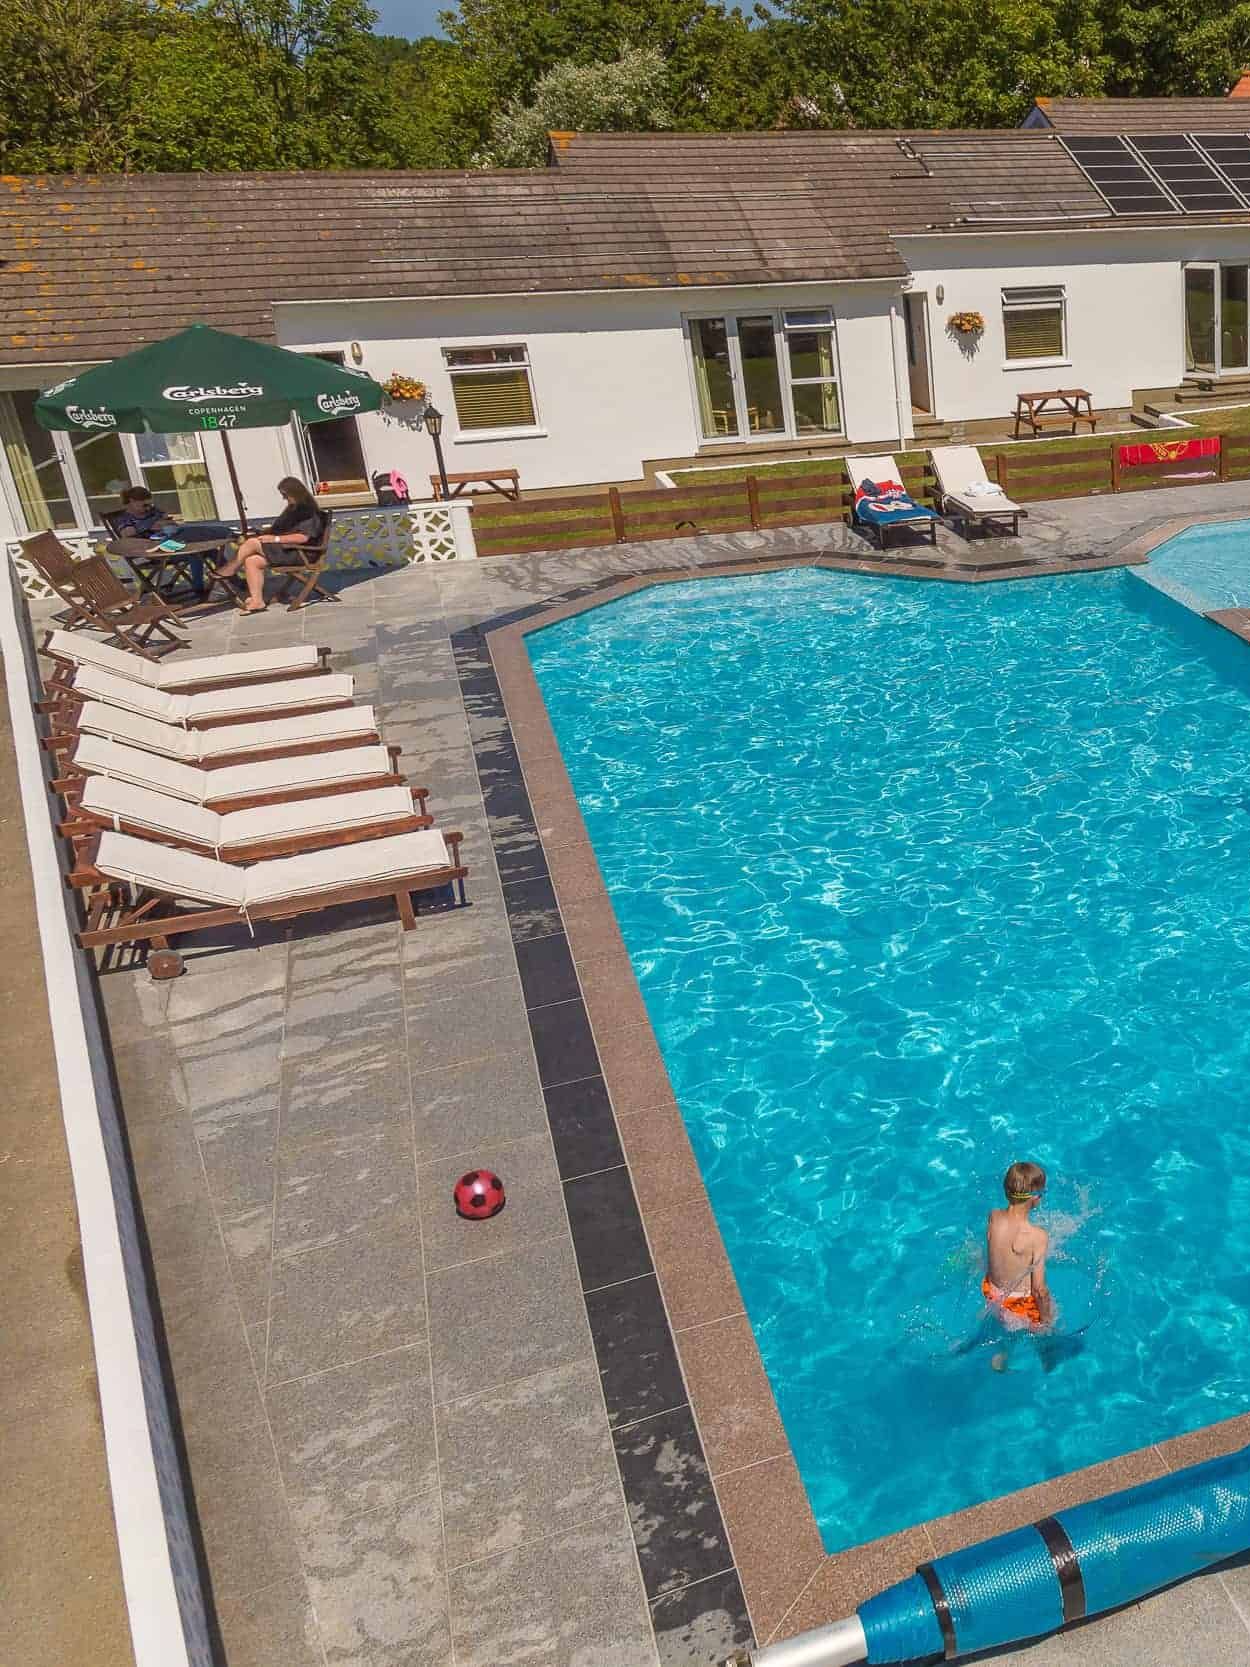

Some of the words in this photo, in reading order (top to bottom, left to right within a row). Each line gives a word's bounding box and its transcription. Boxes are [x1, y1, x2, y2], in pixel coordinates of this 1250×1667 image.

[162, 382, 264, 402] Carlsberg
[188, 405, 247, 415] COPENHAGEN
[317, 390, 361, 415] Carlsberg
[65, 405, 117, 428] Carlsberg
[201, 414, 237, 429] 1847
